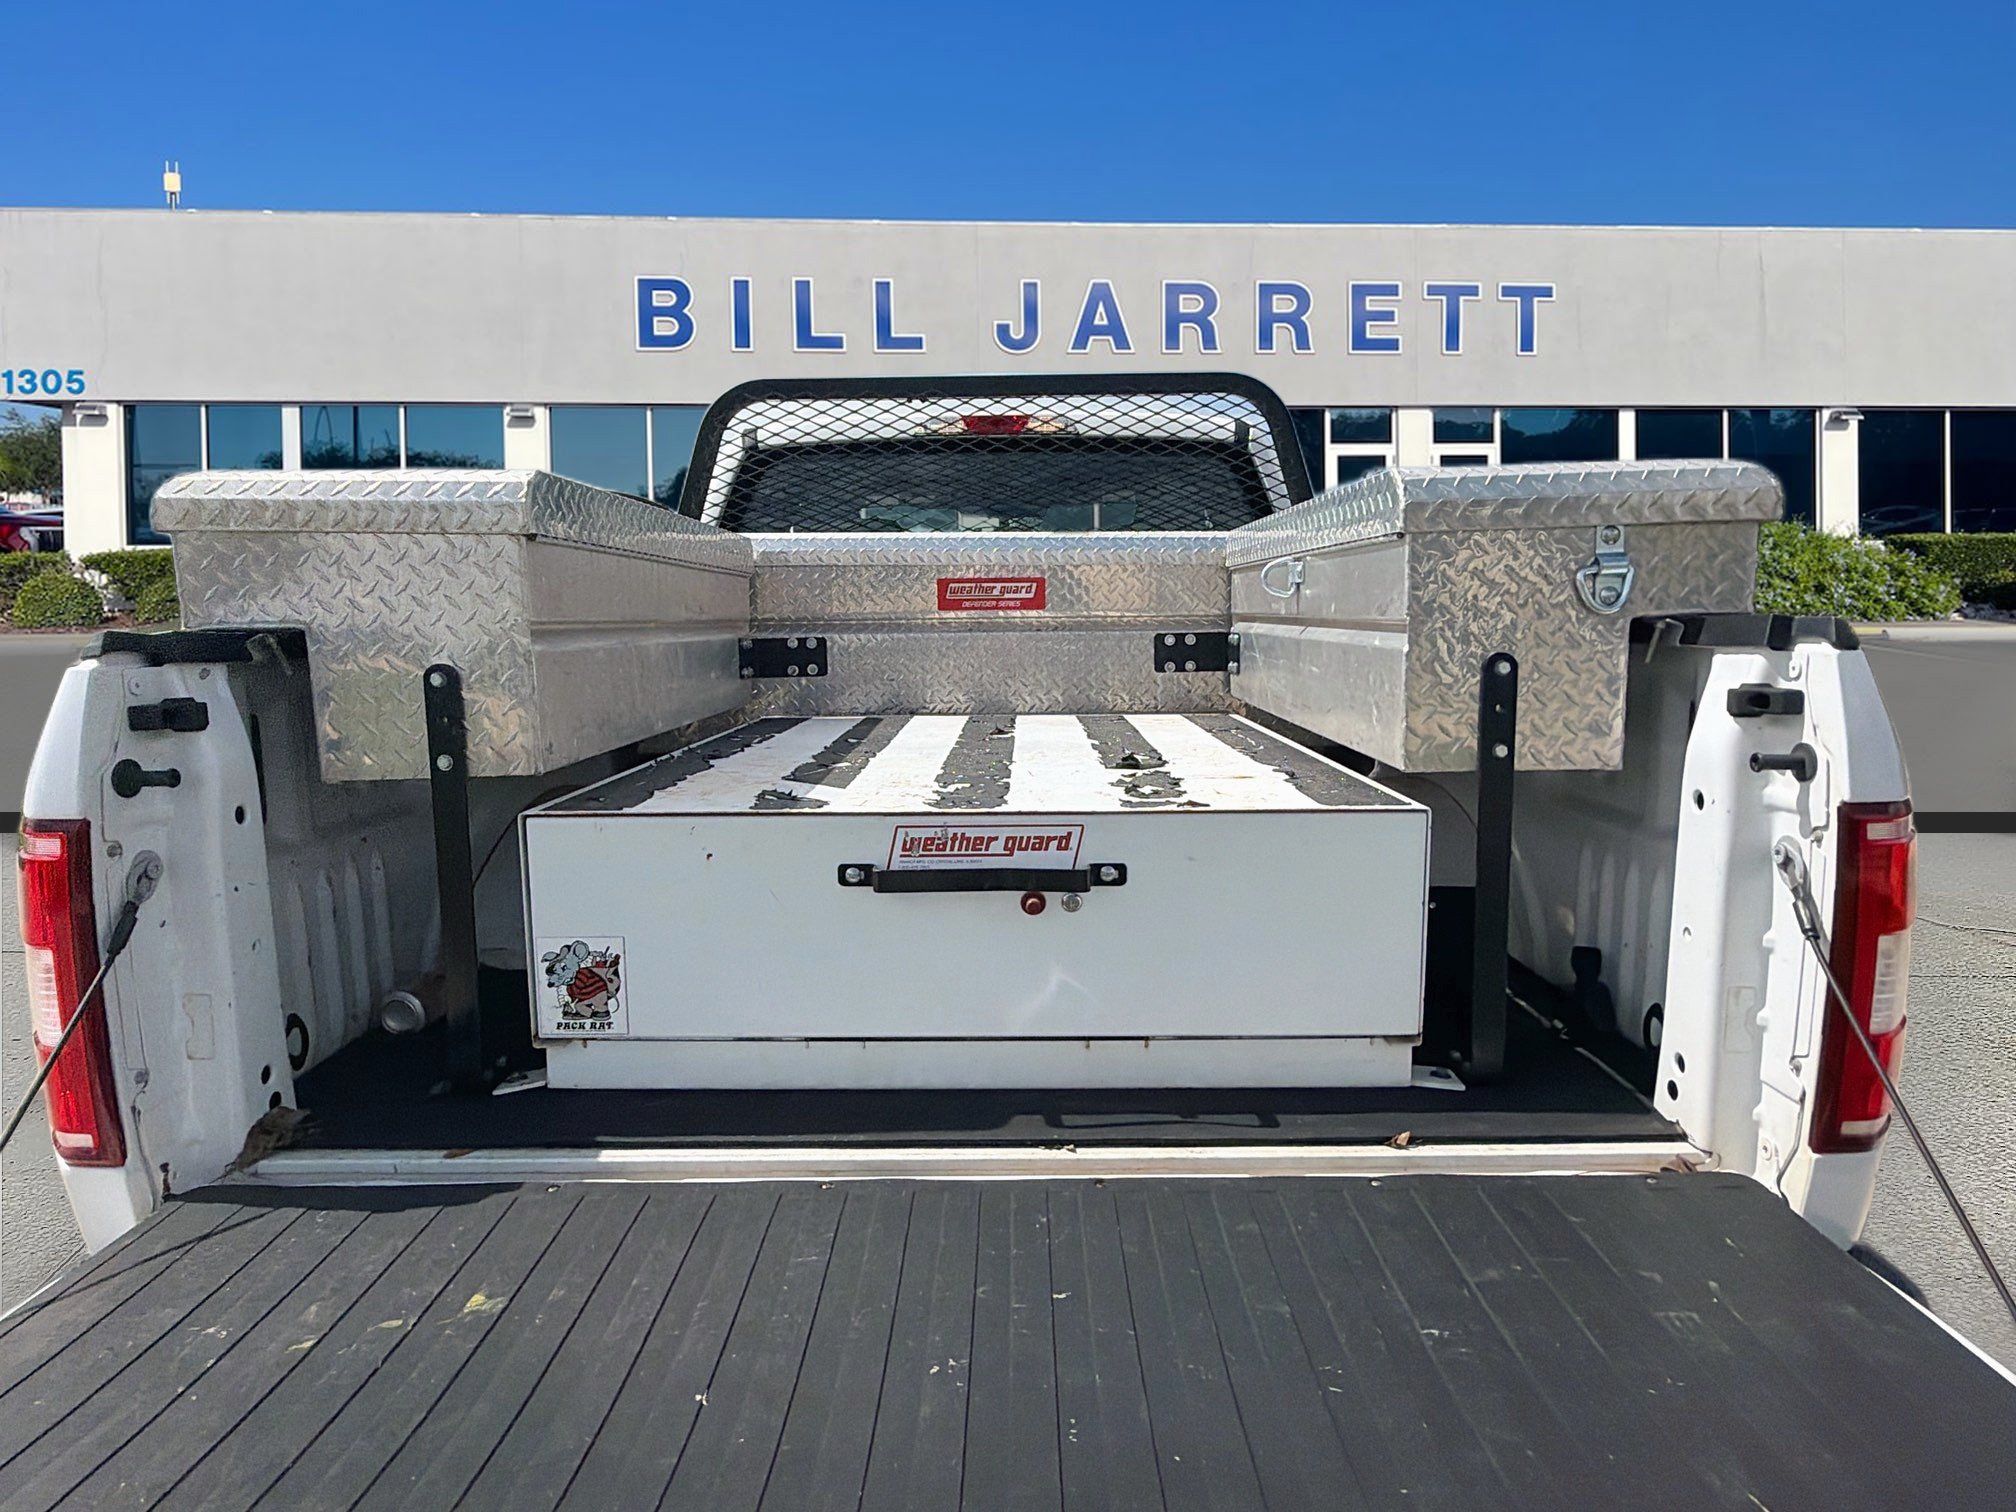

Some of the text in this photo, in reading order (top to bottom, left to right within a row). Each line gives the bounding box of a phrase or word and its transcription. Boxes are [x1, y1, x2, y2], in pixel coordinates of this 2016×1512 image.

[634, 275, 1556, 357] BILL JARRETT
[1, 368, 86, 395] 1305
[949, 583, 1034, 597] weather guard
[901, 830, 1073, 857] weather guard
[556, 1021, 614, 1030] PACK RAT
